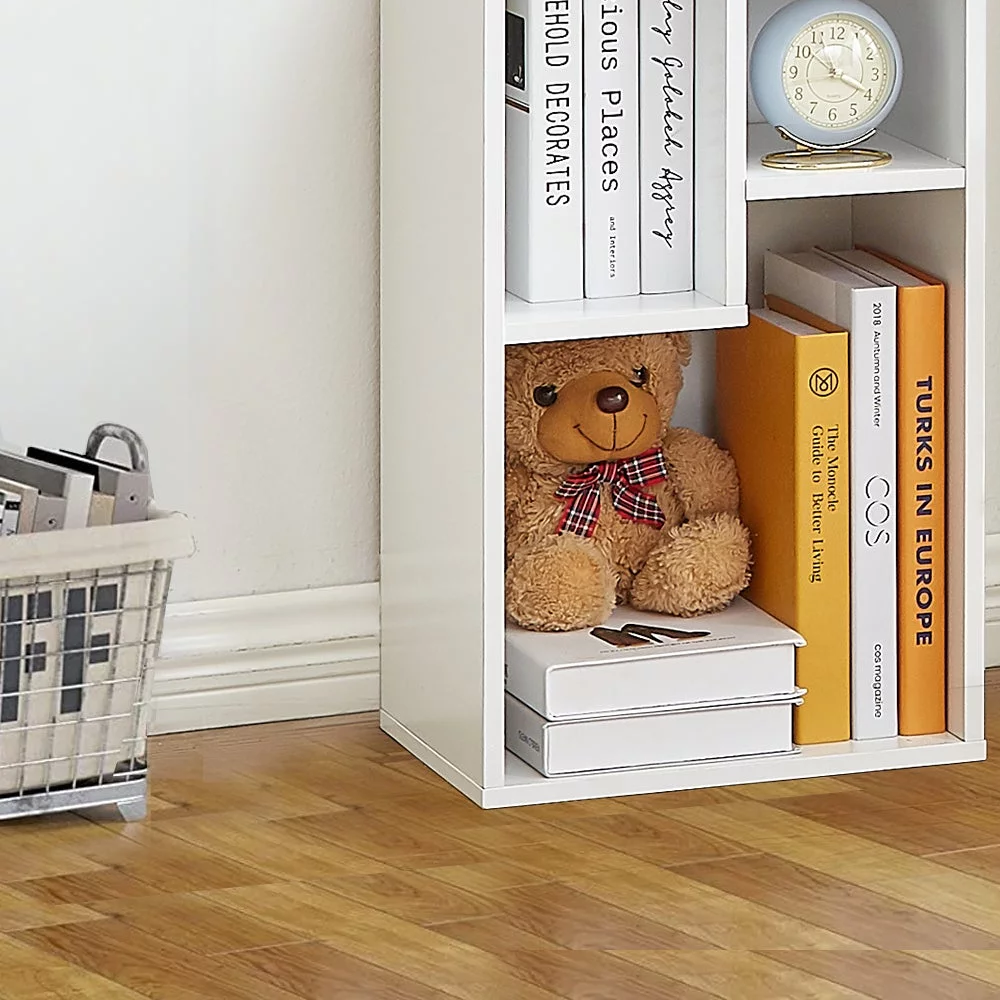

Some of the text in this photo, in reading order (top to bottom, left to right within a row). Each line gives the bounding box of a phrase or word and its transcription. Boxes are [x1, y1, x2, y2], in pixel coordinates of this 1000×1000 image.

[830, 27, 845, 40] 12
[795, 45, 811, 58] 10
[866, 47, 874, 60] 2
[789, 65, 798, 79] 9
[871, 67, 879, 81] 3
[794, 87, 803, 100] 8
[864, 88, 872, 101] 4
[810, 101, 818, 114] 7
[828, 108, 837, 121] 6
[849, 103, 858, 116] 5
[546, 83, 570, 205] DECORATES
[602, 91, 623, 191] Places
[609, 236, 617, 277] Interiors
[872, 303, 882, 325] 2018
[873, 375, 881, 395] and
[873, 396, 881, 427] Winter
[828, 424, 839, 511] The Monocle
[809, 426, 824, 583] Guide to Better Living
[866, 476, 889, 546] COS
[916, 376, 932, 645] TURKS IN EUROPE
[872, 644, 883, 717] cos magazine
